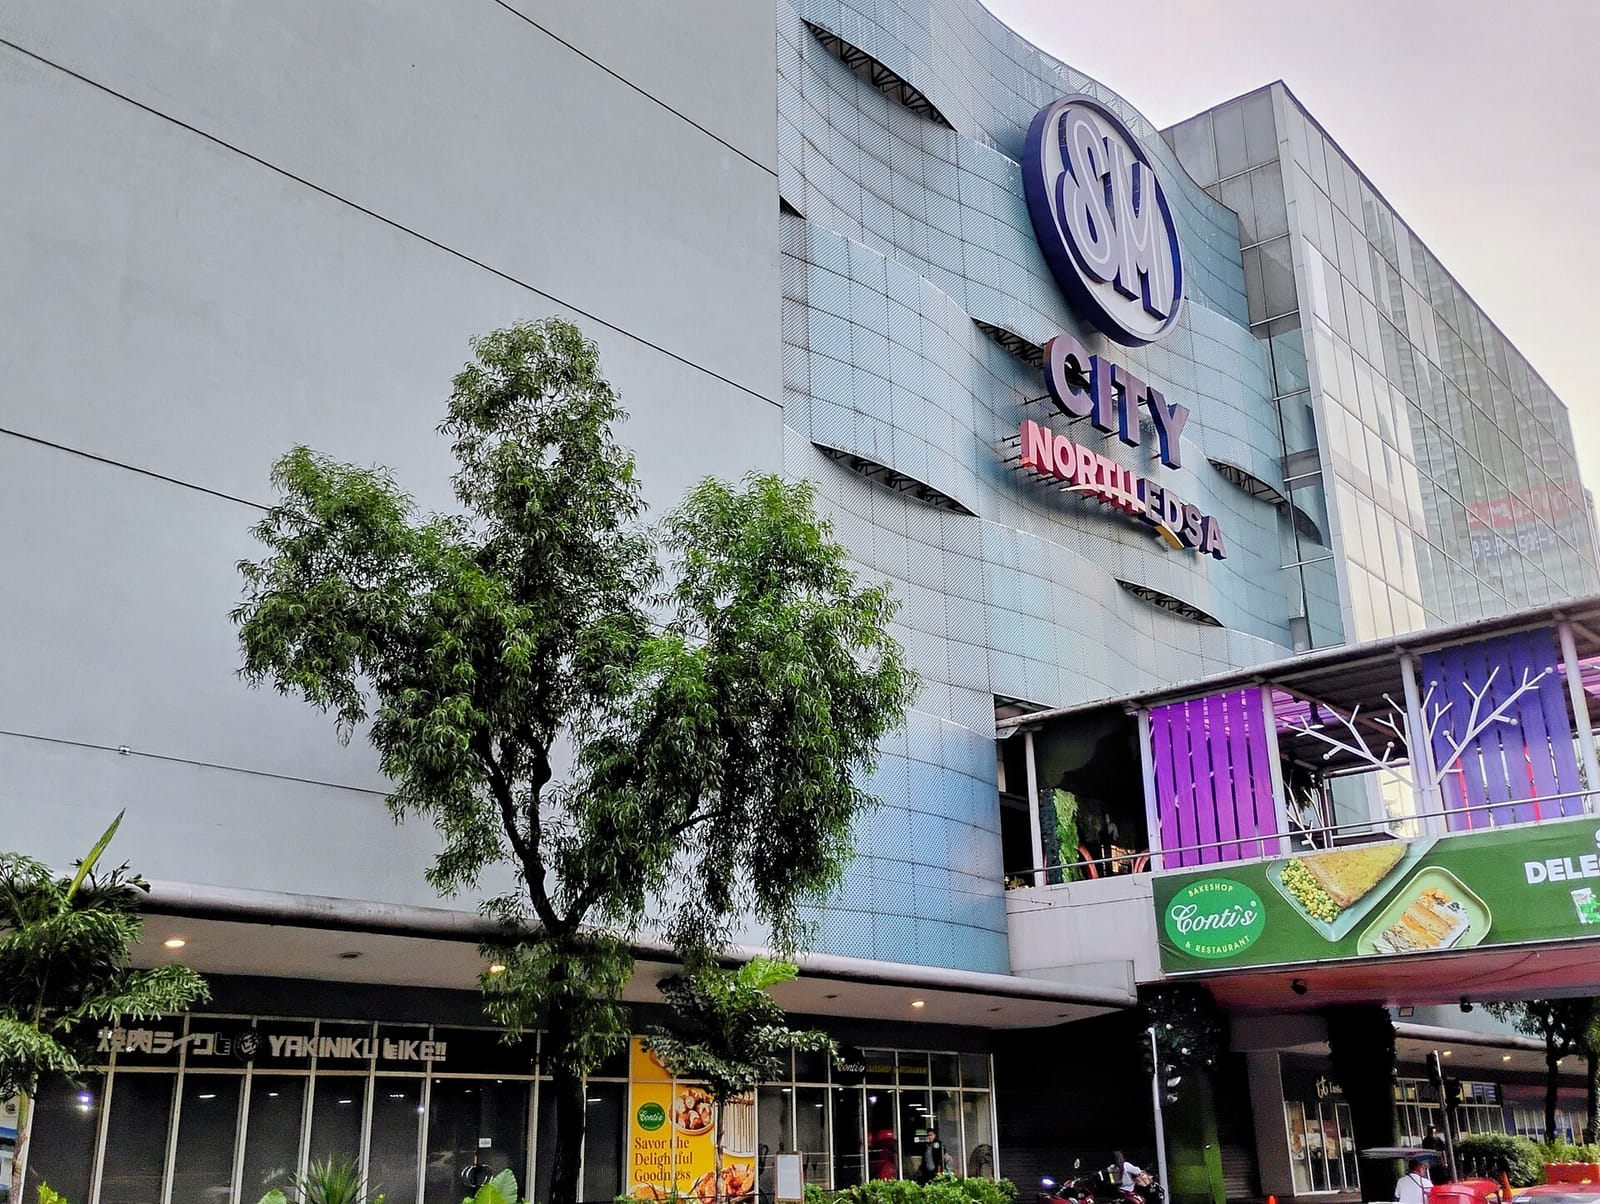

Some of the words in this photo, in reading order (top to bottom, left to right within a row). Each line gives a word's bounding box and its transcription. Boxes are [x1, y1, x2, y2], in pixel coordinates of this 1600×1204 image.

[1057, 107, 1169, 322] SM
[1044, 335, 1190, 471] CITY
[1020, 419, 1143, 515] NORTH
[1137, 477, 1227, 560] EDSA
[1524, 854, 1600, 884] DELE
[1188, 883, 1233, 897] BAKESHOP
[1171, 904, 1258, 935] Conti's
[1185, 941, 1191, 949] &
[1195, 935, 1250, 954] RESTAURANT
[268, 1035, 379, 1059] YAKINIKU
[634, 1137, 667, 1150] Savor
